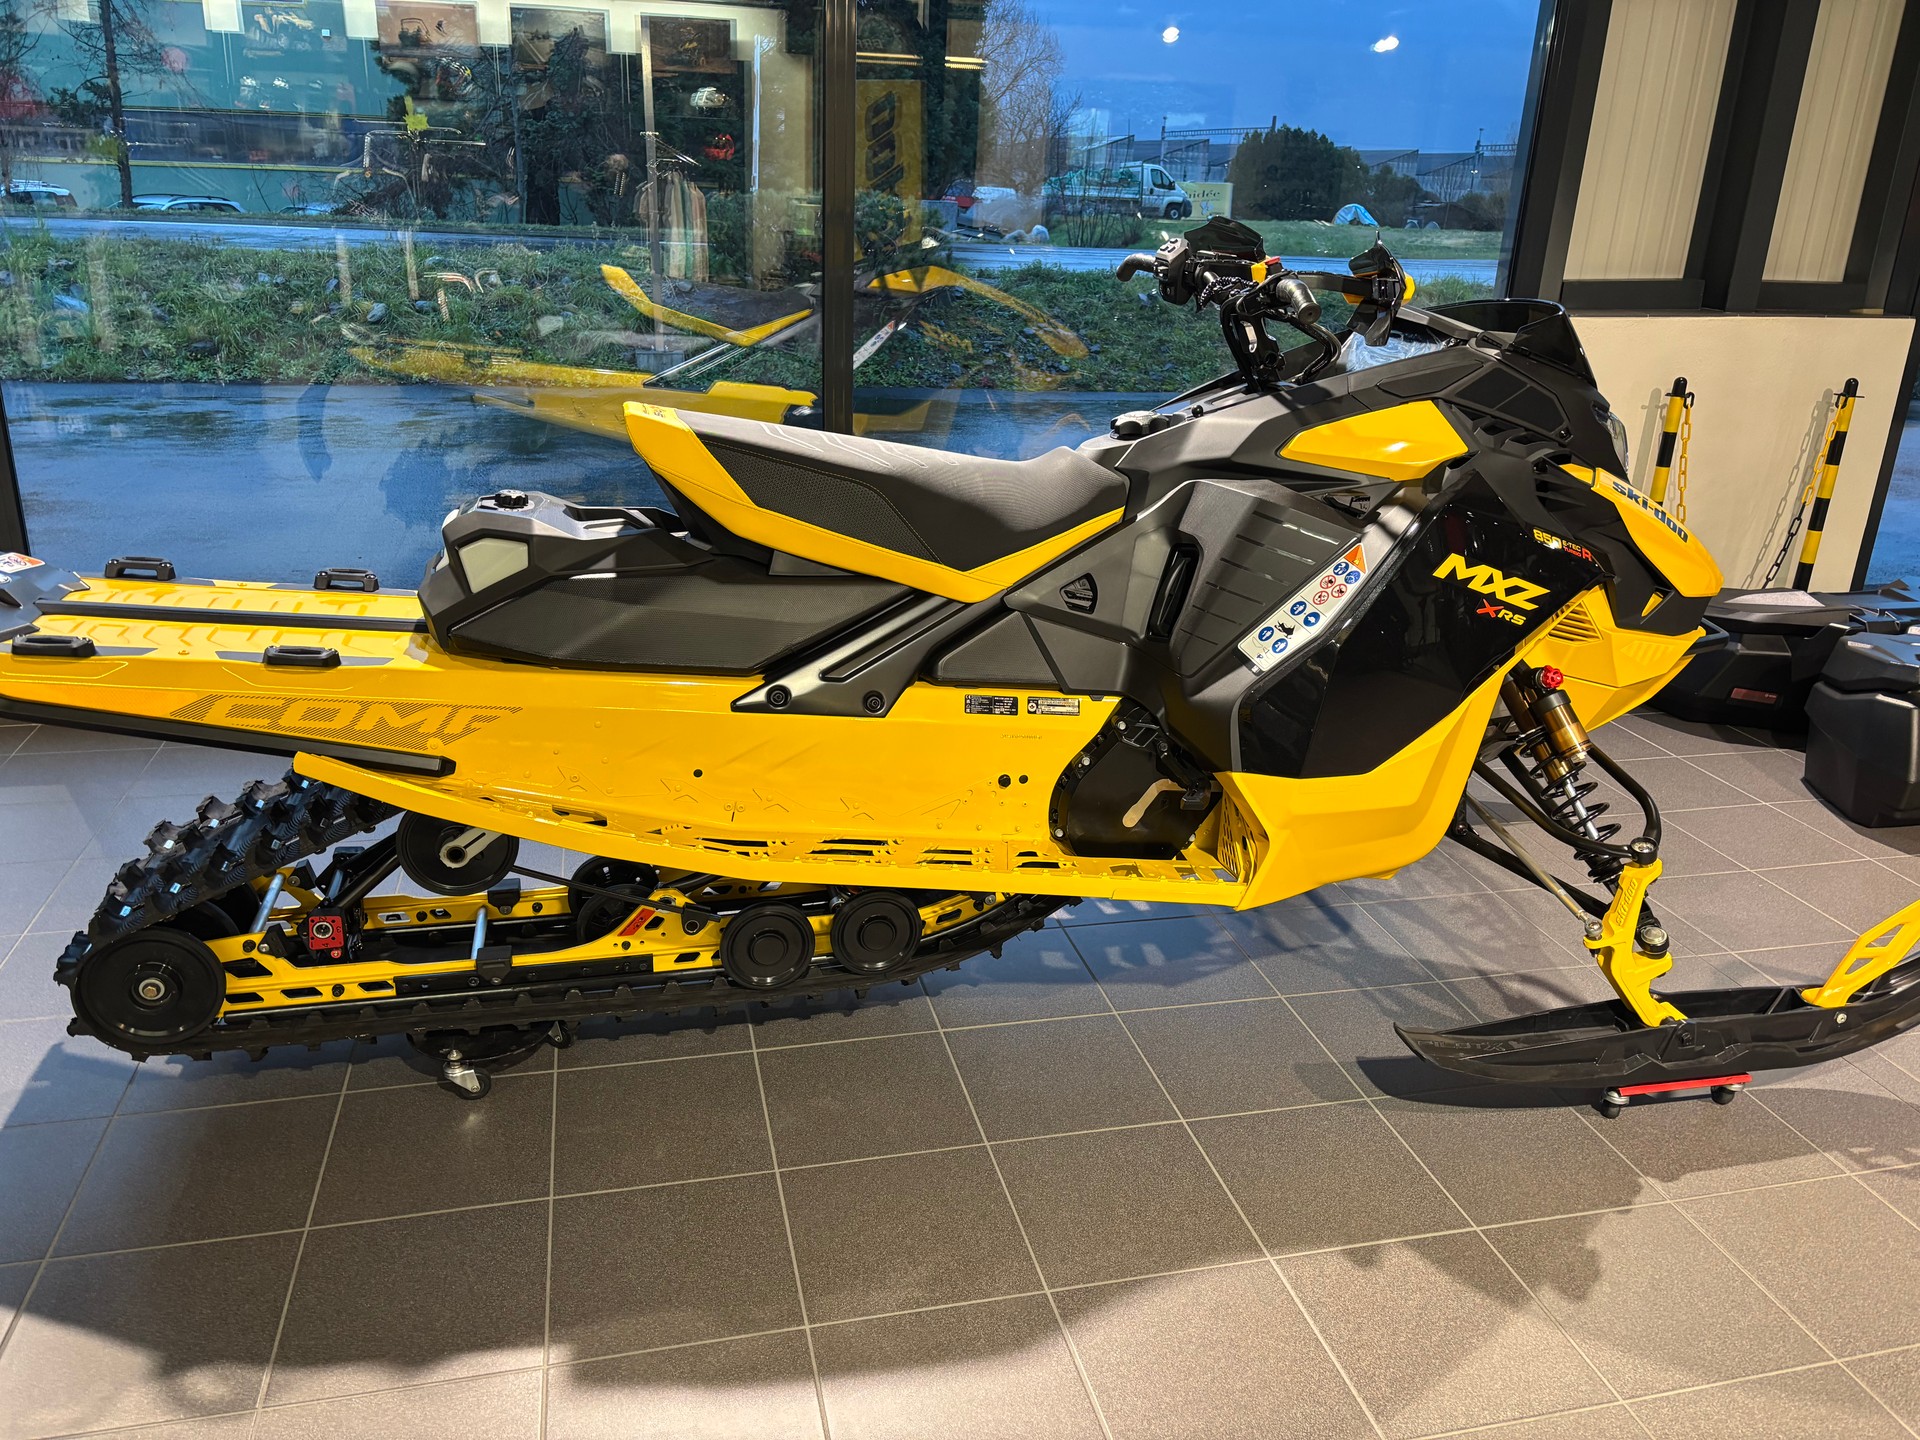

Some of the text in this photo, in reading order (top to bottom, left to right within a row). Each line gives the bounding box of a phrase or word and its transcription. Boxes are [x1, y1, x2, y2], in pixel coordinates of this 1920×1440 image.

[1612, 481, 1689, 543] ski-doo
[1533, 528, 1562, 550] 850
[1582, 547, 1593, 562] R
[1432, 552, 1551, 611] MXZ
